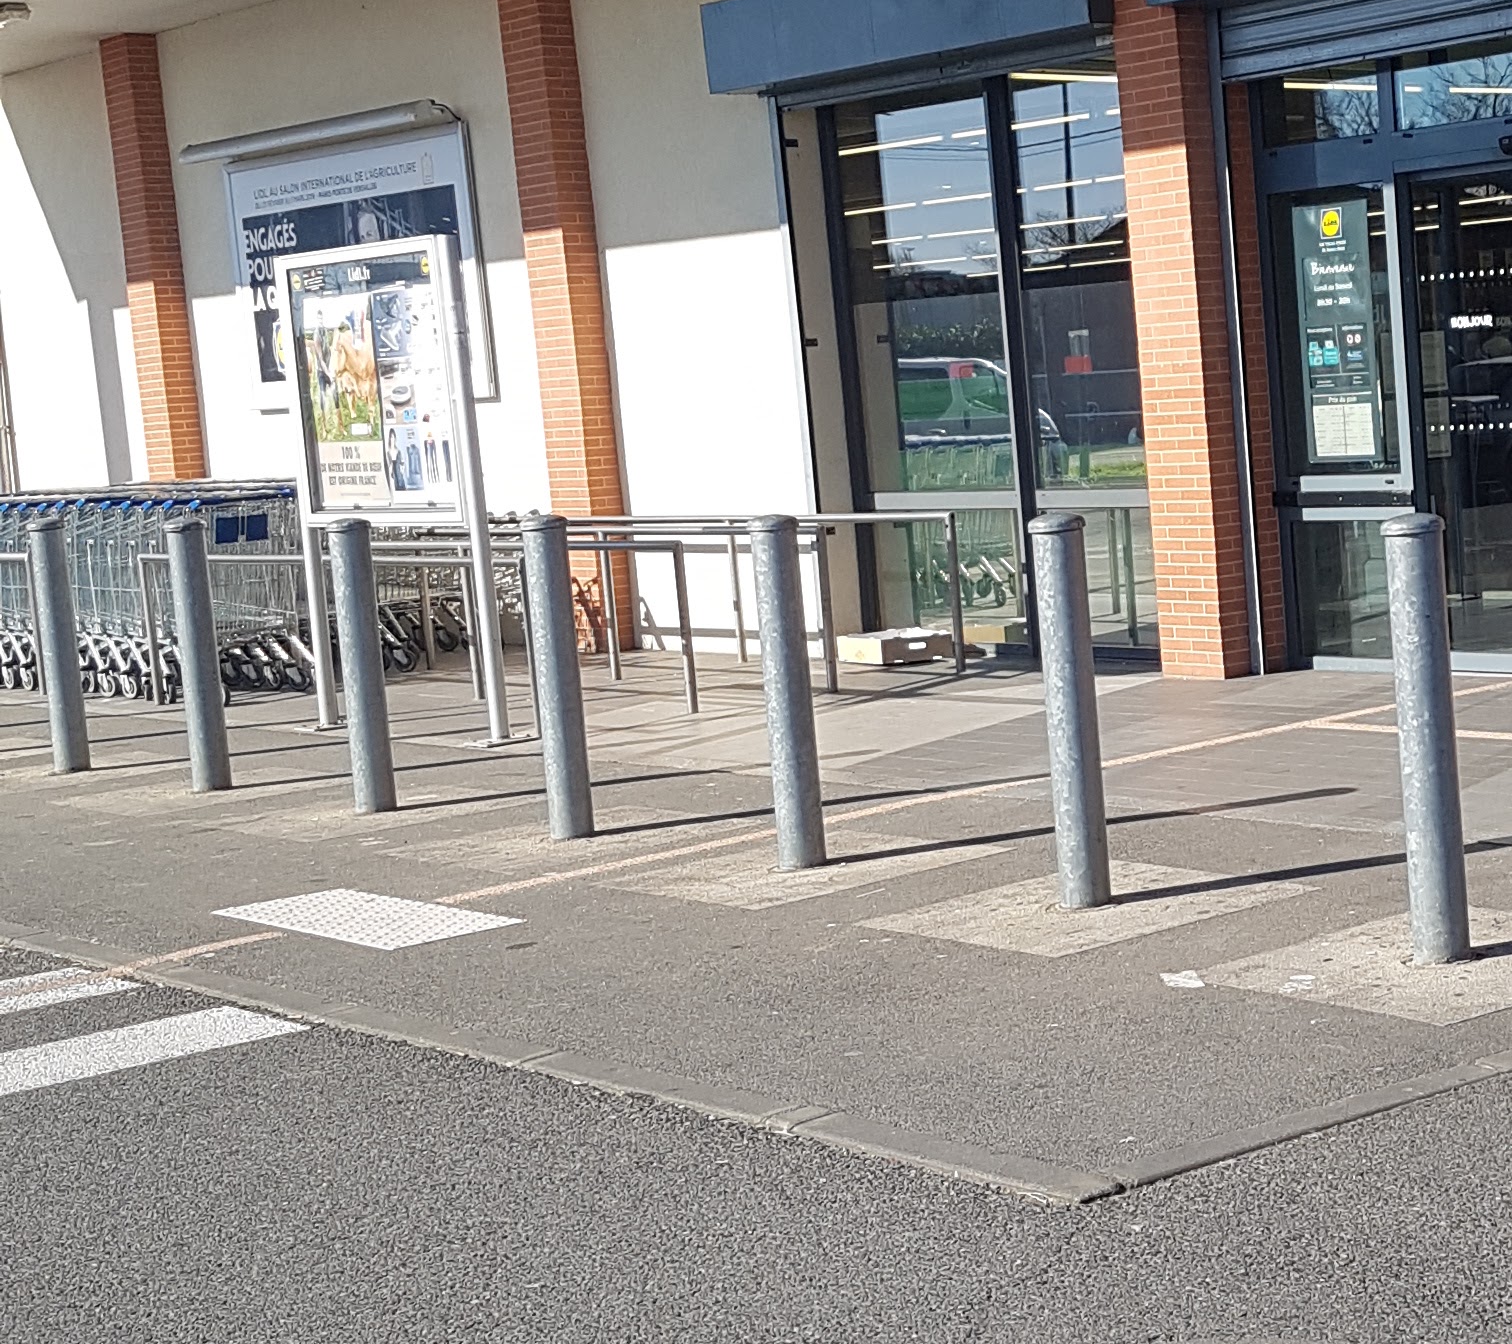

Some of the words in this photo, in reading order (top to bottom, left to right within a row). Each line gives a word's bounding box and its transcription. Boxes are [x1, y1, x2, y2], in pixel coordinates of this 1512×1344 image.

[280, 179, 300, 195] SALON
[301, 171, 353, 191] INTERNATIONAL
[354, 170, 364, 183] DE
[244, 218, 297, 253] ENGAGÉS
[249, 256, 274, 284] POU
[1450, 314, 1494, 330] BONJOUR
